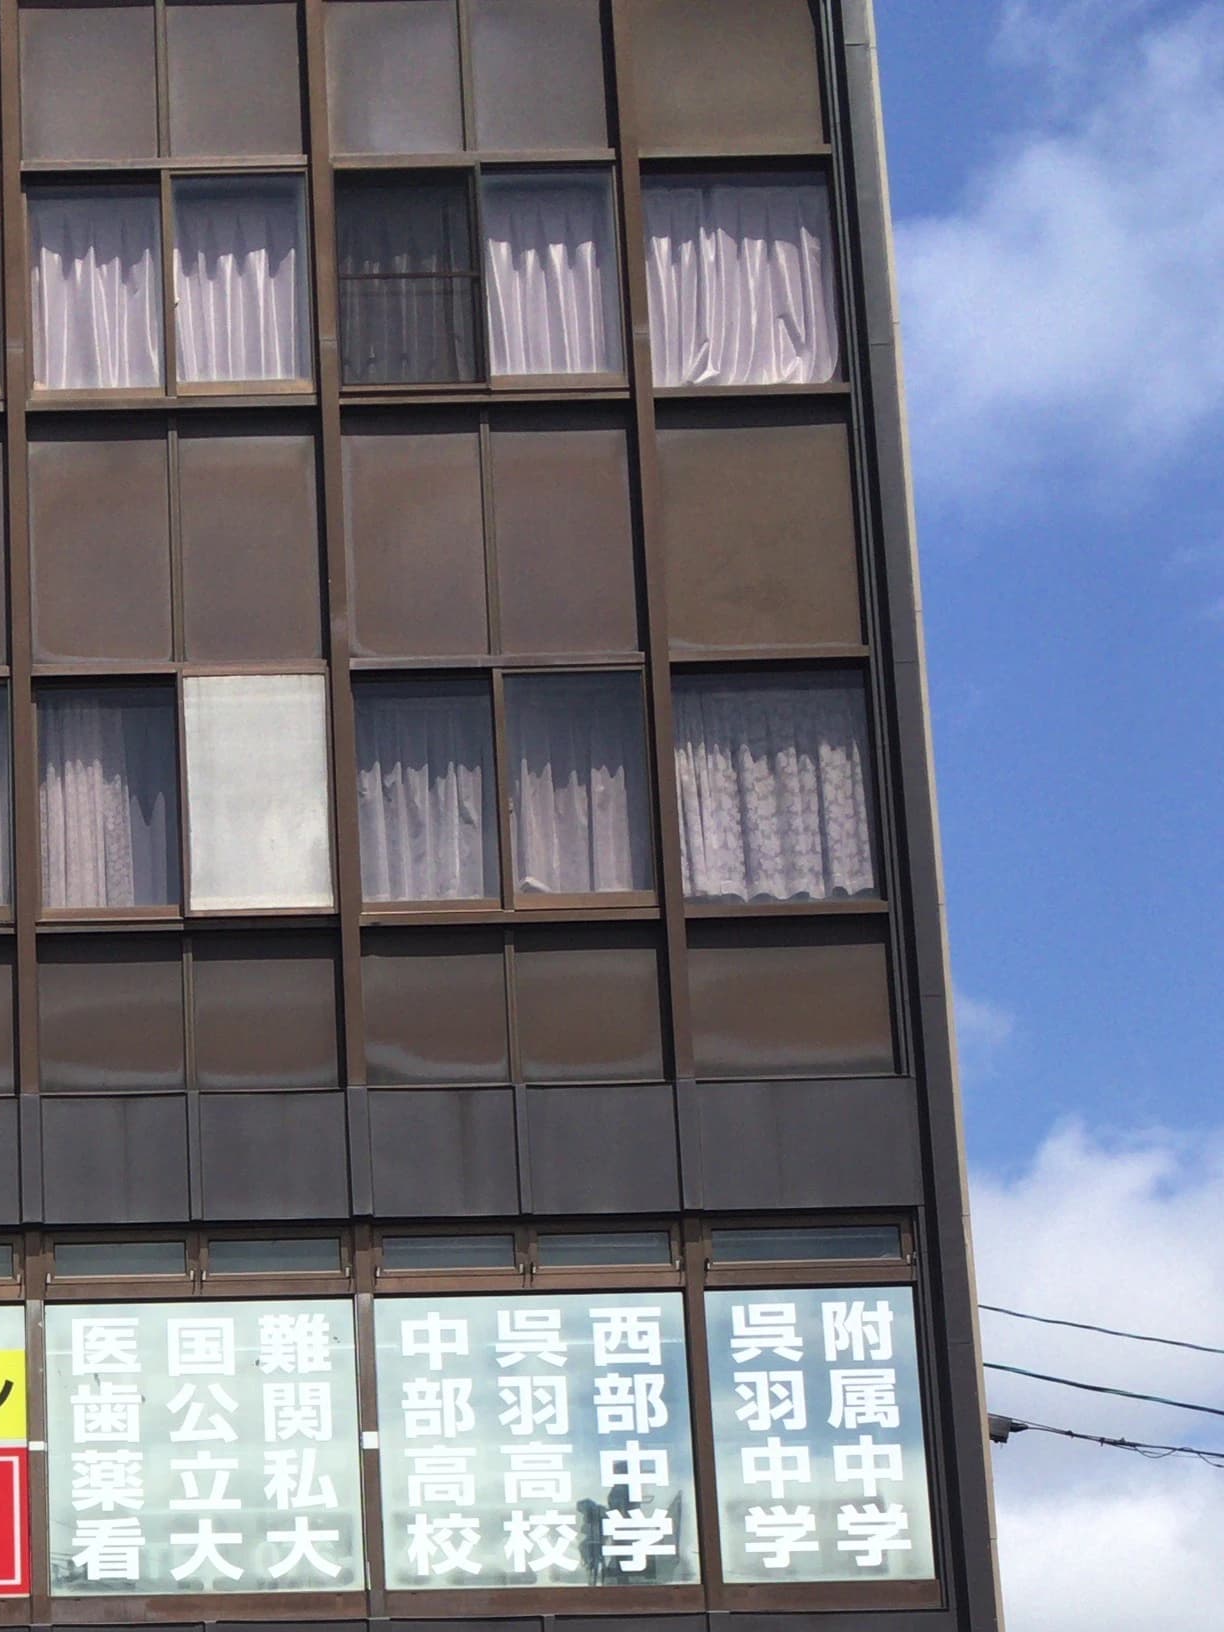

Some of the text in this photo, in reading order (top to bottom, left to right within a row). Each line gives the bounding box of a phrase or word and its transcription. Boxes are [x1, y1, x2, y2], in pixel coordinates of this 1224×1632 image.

[70, 1317, 146, 1582] 医歯薬看
[166, 1317, 244, 1581] 国公立大
[257, 1313, 342, 1579] 難関私大
[400, 1311, 483, 1576] 中部高校
[495, 1308, 578, 1573] 呉羽高校
[589, 1306, 676, 1573] 西部中学
[730, 1302, 820, 1569] 呉羽中学
[821, 1300, 912, 1567] 附属中学
